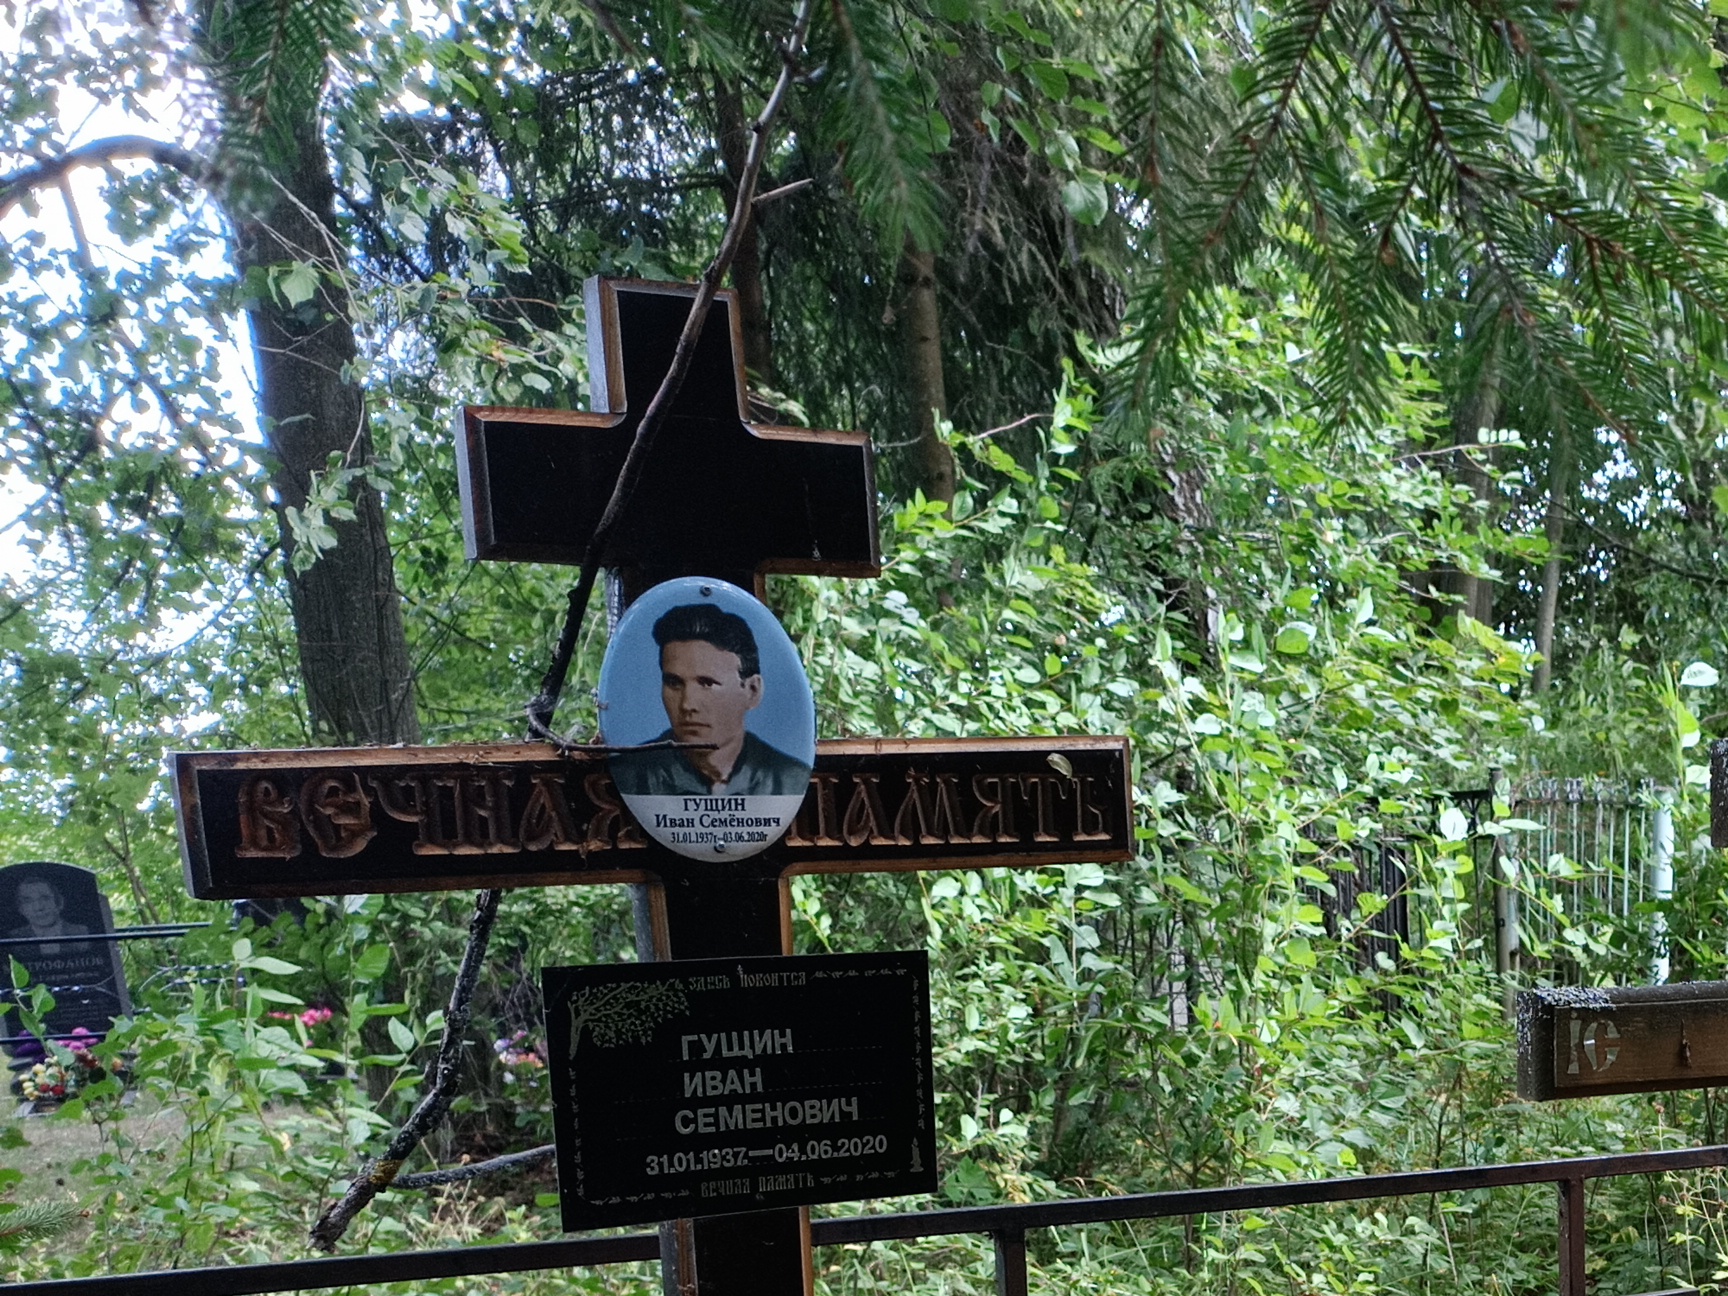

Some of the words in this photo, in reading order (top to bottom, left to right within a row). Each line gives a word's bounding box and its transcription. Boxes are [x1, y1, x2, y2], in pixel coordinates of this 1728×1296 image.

[655, 814, 695, 828] Иван
[699, 813, 781, 828] Семёнович
[683, 798, 746, 812] ГУЩИН
[784, 771, 1113, 848] ПАМЯТЬ
[681, 1028, 795, 1061] ГУЩИН
[684, 1067, 764, 1099] ИВАН
[674, 1096, 860, 1136] СЕМЕНОВИЧ
